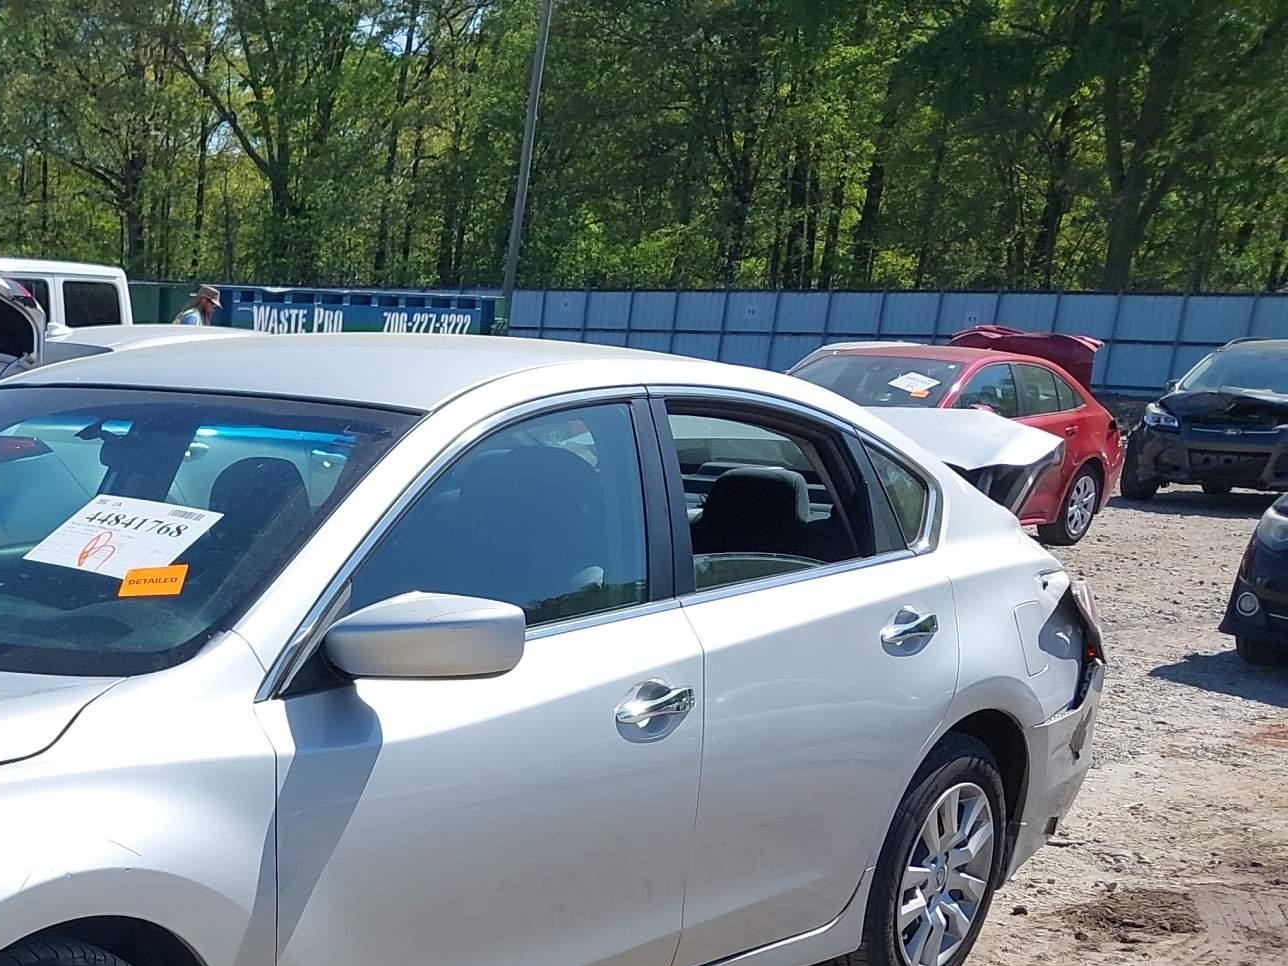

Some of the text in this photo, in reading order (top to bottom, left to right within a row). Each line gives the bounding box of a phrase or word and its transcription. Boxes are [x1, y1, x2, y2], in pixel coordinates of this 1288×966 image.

[253, 305, 307, 334] WASTE
[313, 304, 343, 334] PRO
[85, 511, 189, 538] 44841768
[128, 576, 178, 586] DETAILED
